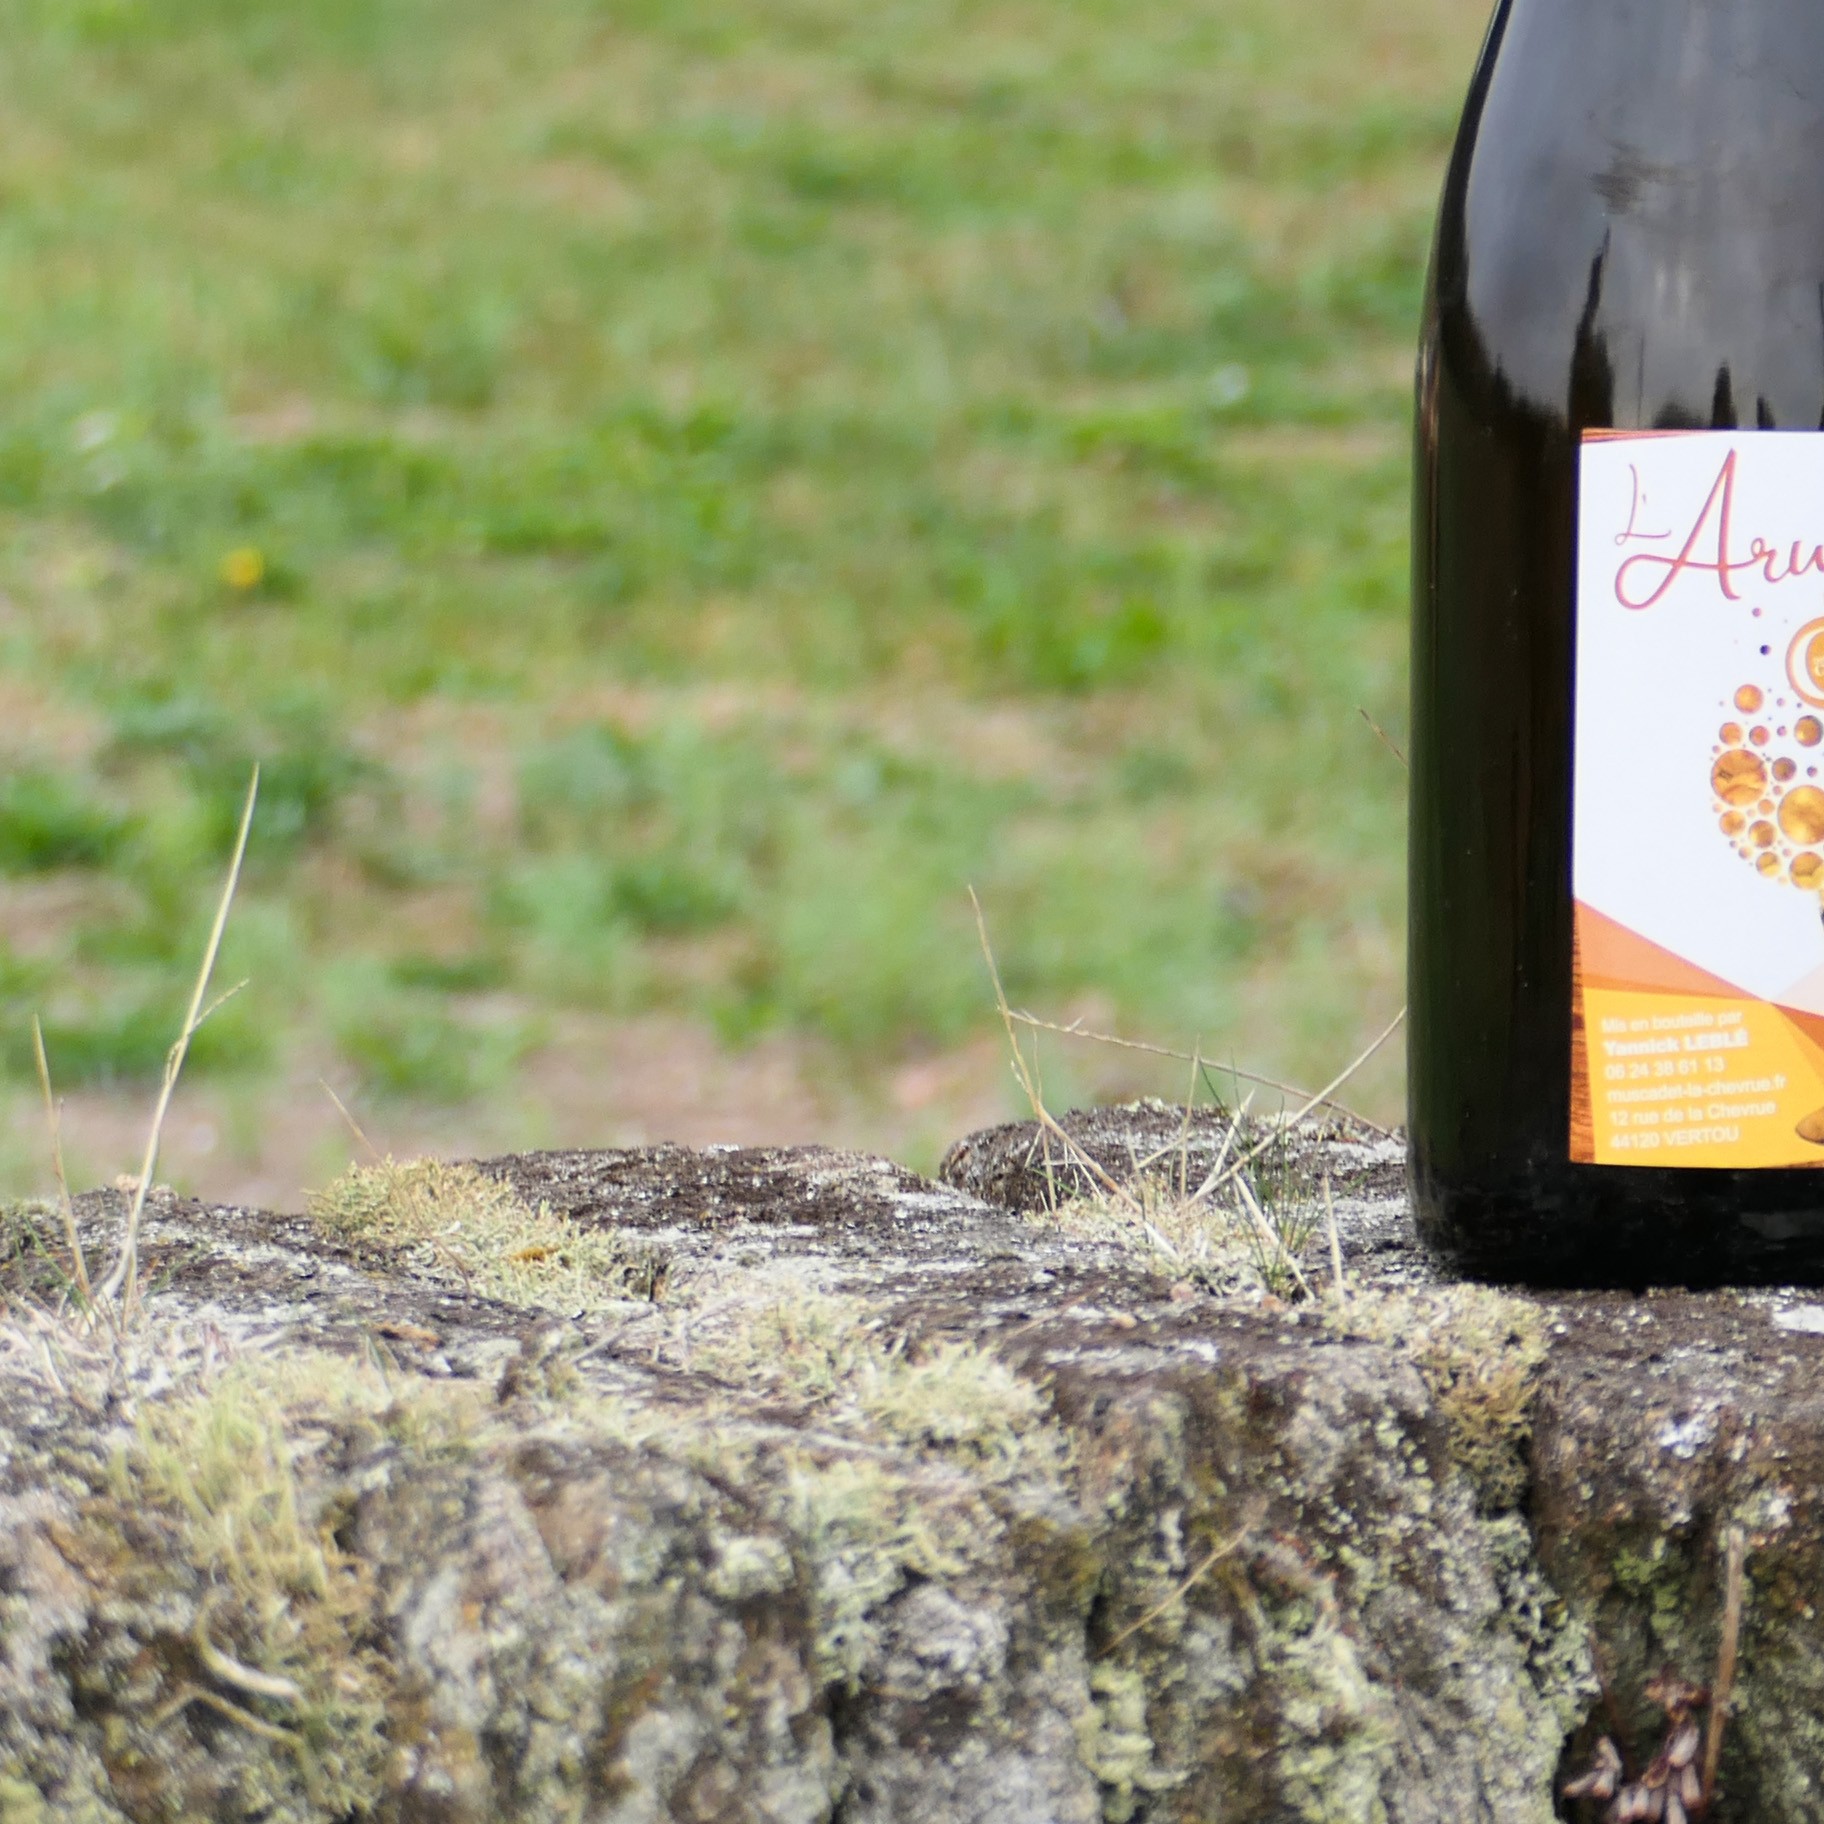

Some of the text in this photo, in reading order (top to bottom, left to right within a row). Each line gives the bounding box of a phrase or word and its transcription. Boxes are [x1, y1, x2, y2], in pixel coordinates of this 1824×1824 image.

[1630, 1019, 1649, 1032] en
[1603, 1037, 1680, 1056] Yannick
[1605, 1056, 1725, 1080] 06 24 38 61 13
[1611, 1101, 1776, 1126] 12 rue de la Chevrue
[1611, 1126, 1739, 1148] 44120 VERTOU
